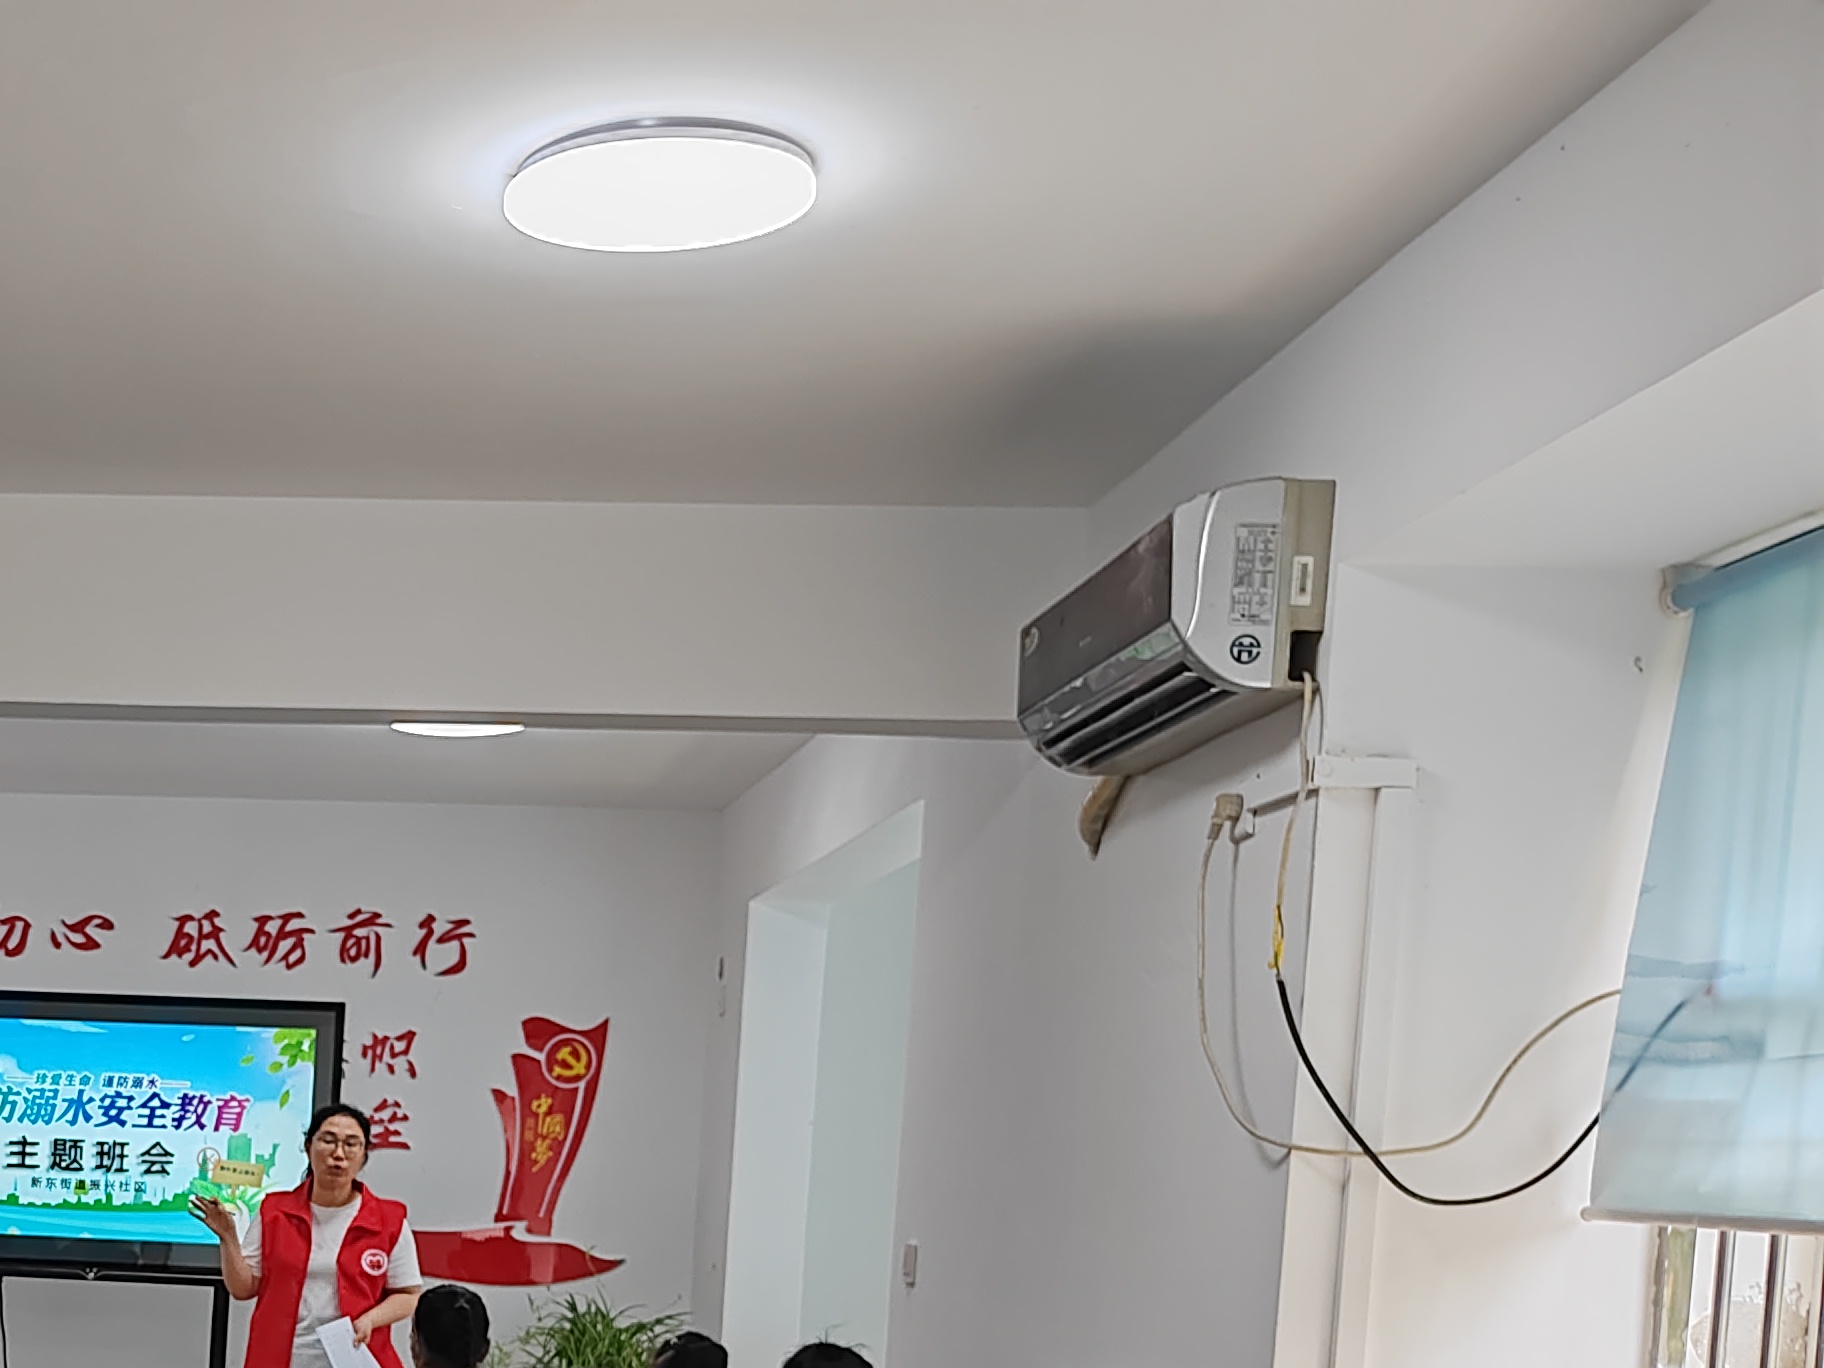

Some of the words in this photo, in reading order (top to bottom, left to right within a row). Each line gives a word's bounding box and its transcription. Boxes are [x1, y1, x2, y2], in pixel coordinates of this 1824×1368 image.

[159, 908, 476, 979] 砥砺前行
[343, 1029, 417, 1079] 帜
[35, 1072, 92, 1087] 珍爱生命
[5, 1136, 175, 1176] 主题班会
